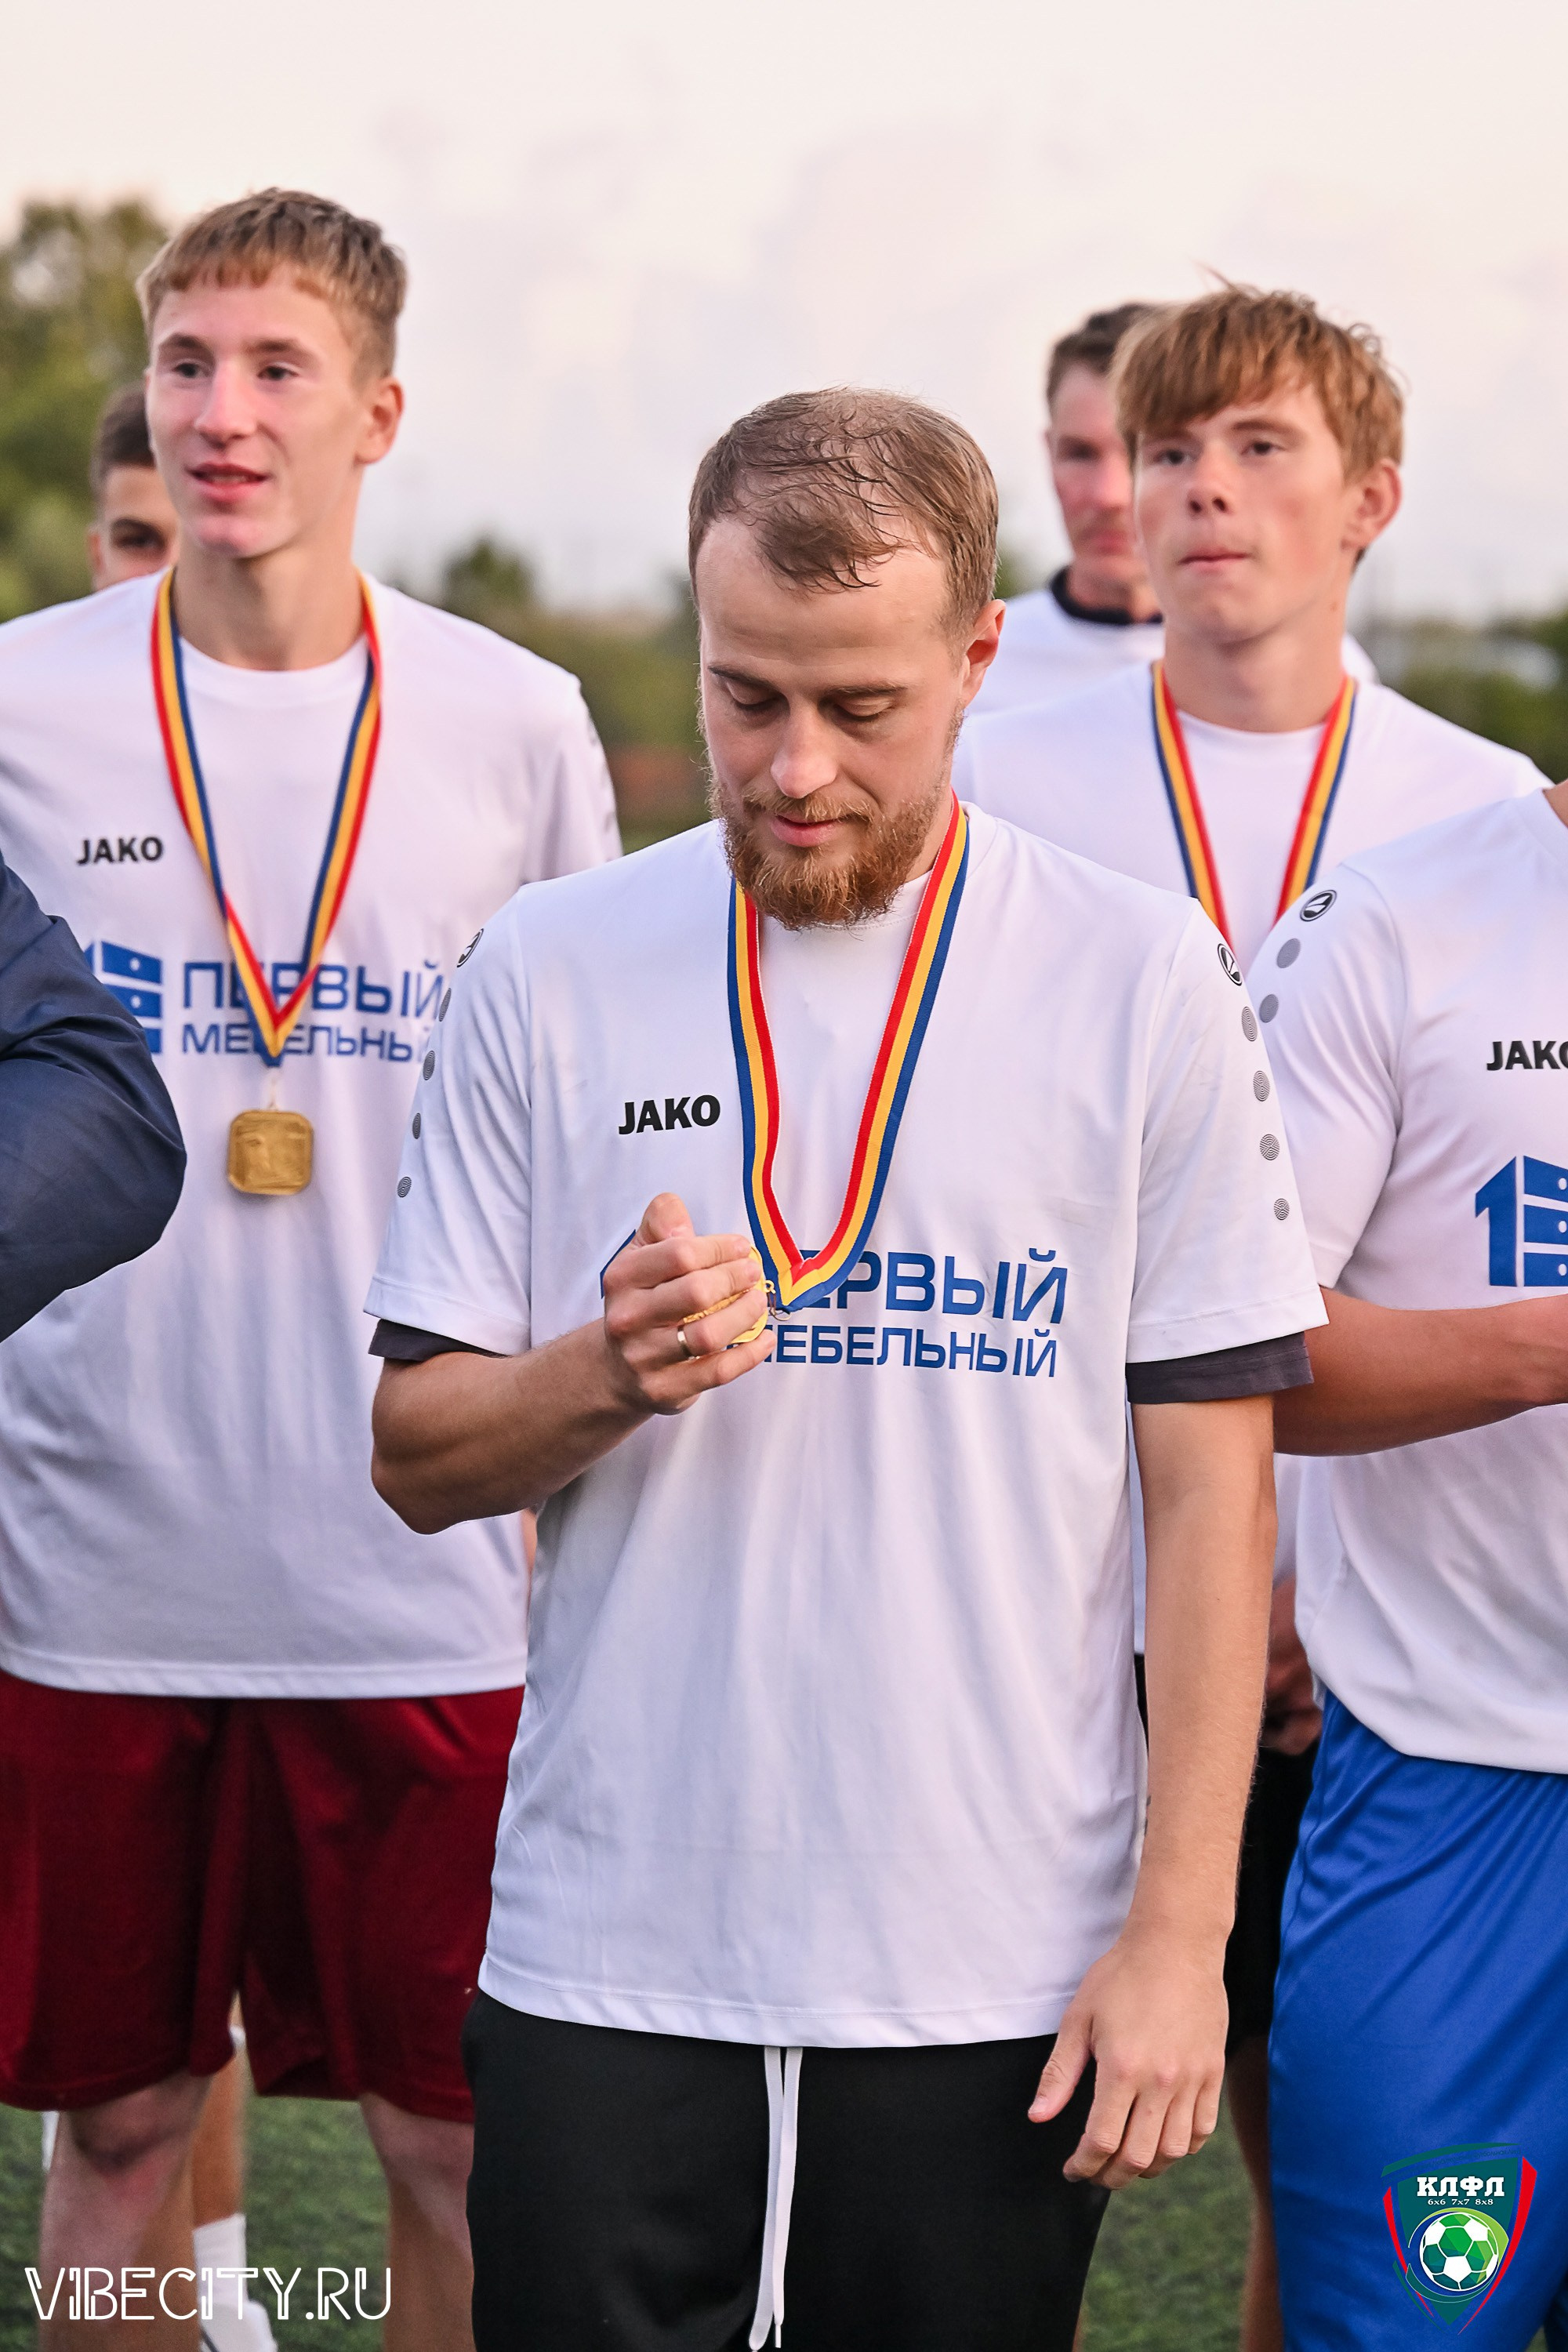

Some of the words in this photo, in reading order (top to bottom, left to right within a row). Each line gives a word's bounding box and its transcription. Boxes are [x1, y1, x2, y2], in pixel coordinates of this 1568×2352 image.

[77, 836, 164, 866] JAKO
[619, 1094, 720, 1134] JAKO
[799, 1247, 1068, 1324] РВЫЙ
[764, 1324, 1057, 1377] ЕБЕЛЬНЫЙ
